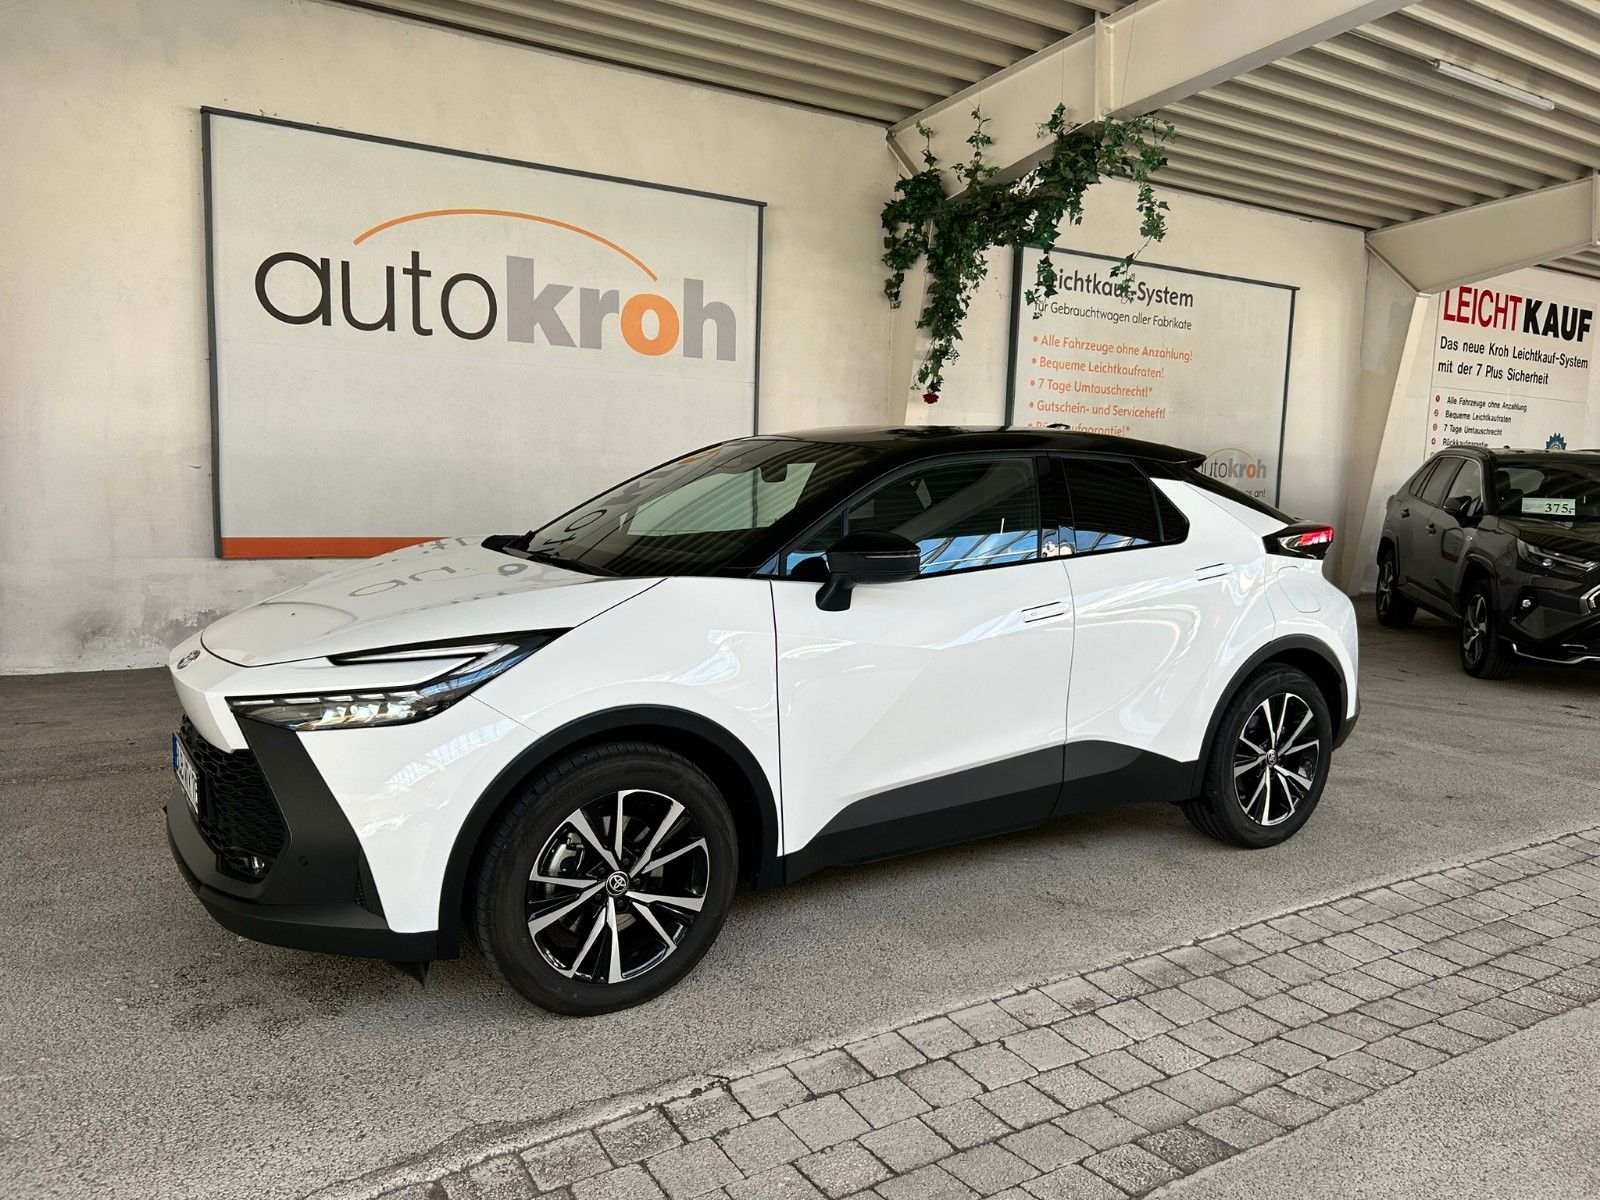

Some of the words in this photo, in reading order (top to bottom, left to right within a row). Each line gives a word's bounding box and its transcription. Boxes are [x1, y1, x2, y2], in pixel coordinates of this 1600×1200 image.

[255, 251, 737, 362] autokroh
[1050, 302, 1130, 324] Gebrauchtwagen
[1132, 312, 1151, 325] aller
[1152, 315, 1193, 331] Fabrikate
[1443, 286, 1593, 343] LEICHTKAUF
[1041, 335, 1061, 347] Alle
[1063, 337, 1114, 355] Fahrzeuge
[1116, 343, 1140, 355] ohne
[1141, 346, 1193, 363] Anzahlung!
[1440, 336, 1458, 351] Das
[1462, 341, 1485, 354] neue
[1488, 343, 1509, 358] Kroh
[1512, 346, 1588, 369] Leichtkauf-System
[1039, 356, 1086, 371] Bequeme
[1088, 362, 1164, 378] Leichtkaufraten!
[1438, 360, 1453, 373] mit
[1457, 362, 1473, 375] der
[1476, 364, 1483, 376] 7
[1485, 365, 1503, 380] Plus
[1507, 368, 1549, 385] Sicherheit
[1038, 378, 1045, 389] 7
[1046, 379, 1071, 392] Tage
[1037, 400, 1090, 413] Gutschein-
[1092, 405, 1110, 416] und
[1112, 405, 1166, 419] Serviceheft!
[1447, 396, 1457, 404] Alle
[1459, 397, 1486, 409] Fahrzeuge
[1488, 401, 1500, 409] ohne
[1501, 402, 1528, 412] Anzahlung
[1445, 410, 1471, 420] Bequeme
[1472, 413, 1512, 423] Leichtkaufraten
[1443, 424, 1448, 432] 7
[1450, 425, 1462, 434] Tage
[1464, 426, 1503, 436] Umtauschrecht
